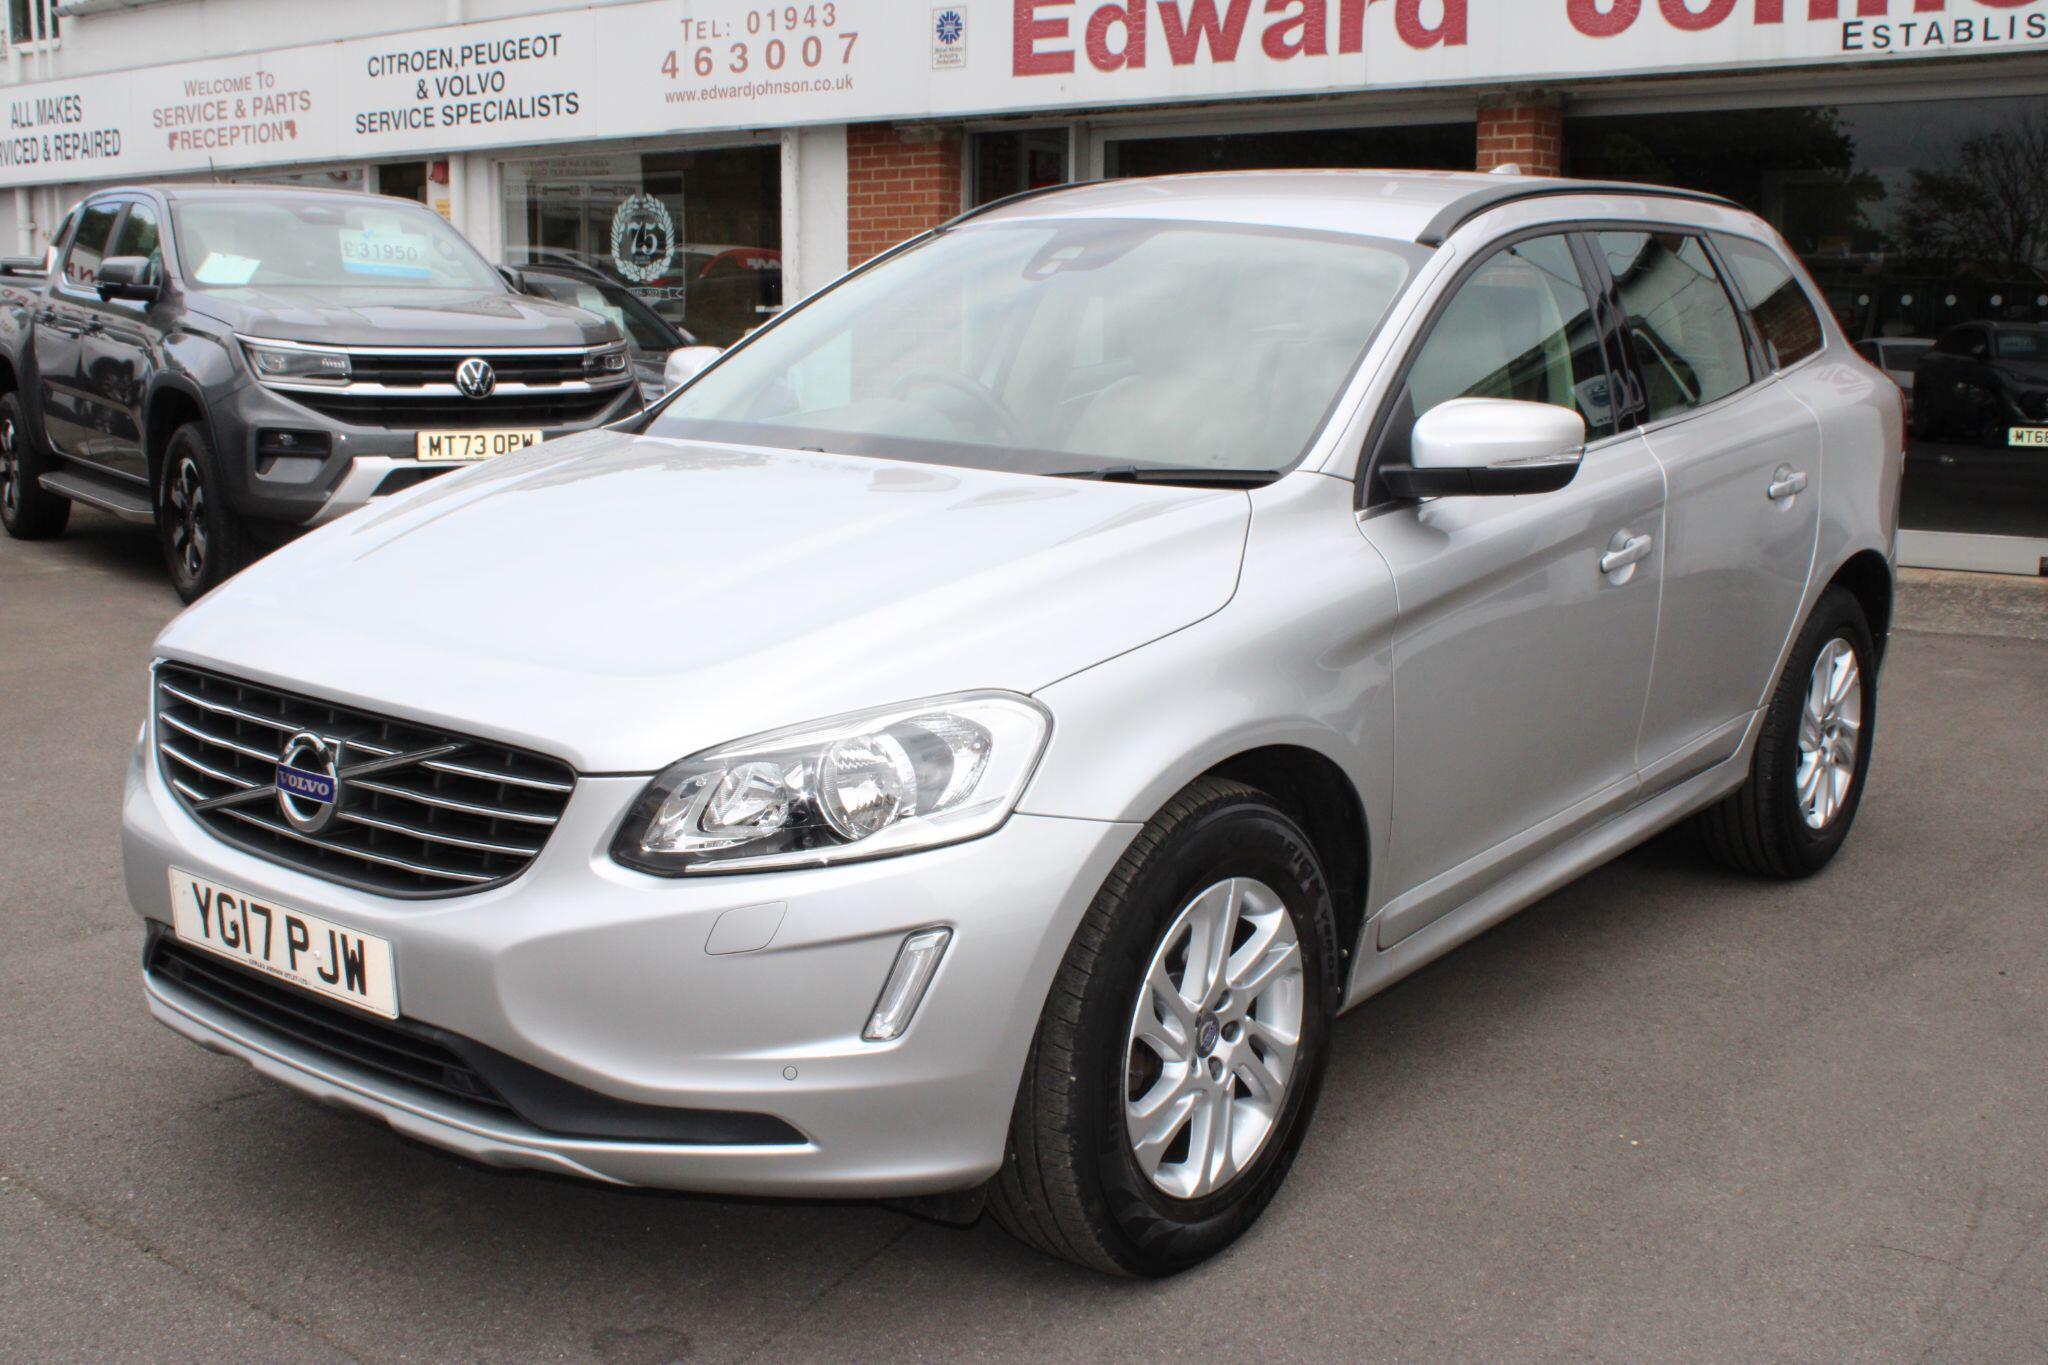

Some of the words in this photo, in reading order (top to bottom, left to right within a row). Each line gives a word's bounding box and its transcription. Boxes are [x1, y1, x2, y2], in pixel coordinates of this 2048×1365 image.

[746, 2, 836, 34] 01943
[660, 31, 859, 80] 463007
[1012, 0, 1468, 77] Edward
[416, 78, 429, 100] &
[435, 70, 505, 98] VOLVO
[664, 73, 853, 103] www.edwardjohnson.co.uk
[11, 101, 33, 129] ALL
[36, 94, 82, 126] MAKES
[152, 100, 228, 129] SERVICE
[234, 98, 246, 119] &
[252, 90, 312, 117] PARTS
[355, 106, 436, 134] SERVICE
[442, 92, 580, 126] SPECIALISTS
[43, 134, 52, 162] &
[54, 129, 121, 161] REPAIRED
[180, 121, 285, 150] RECEPTION
[627, 220, 658, 256] 75
[428, 435, 487, 457] MT73
[279, 770, 330, 796] VOLVO
[192, 881, 272, 962] YG17
[285, 914, 367, 997] PJW
